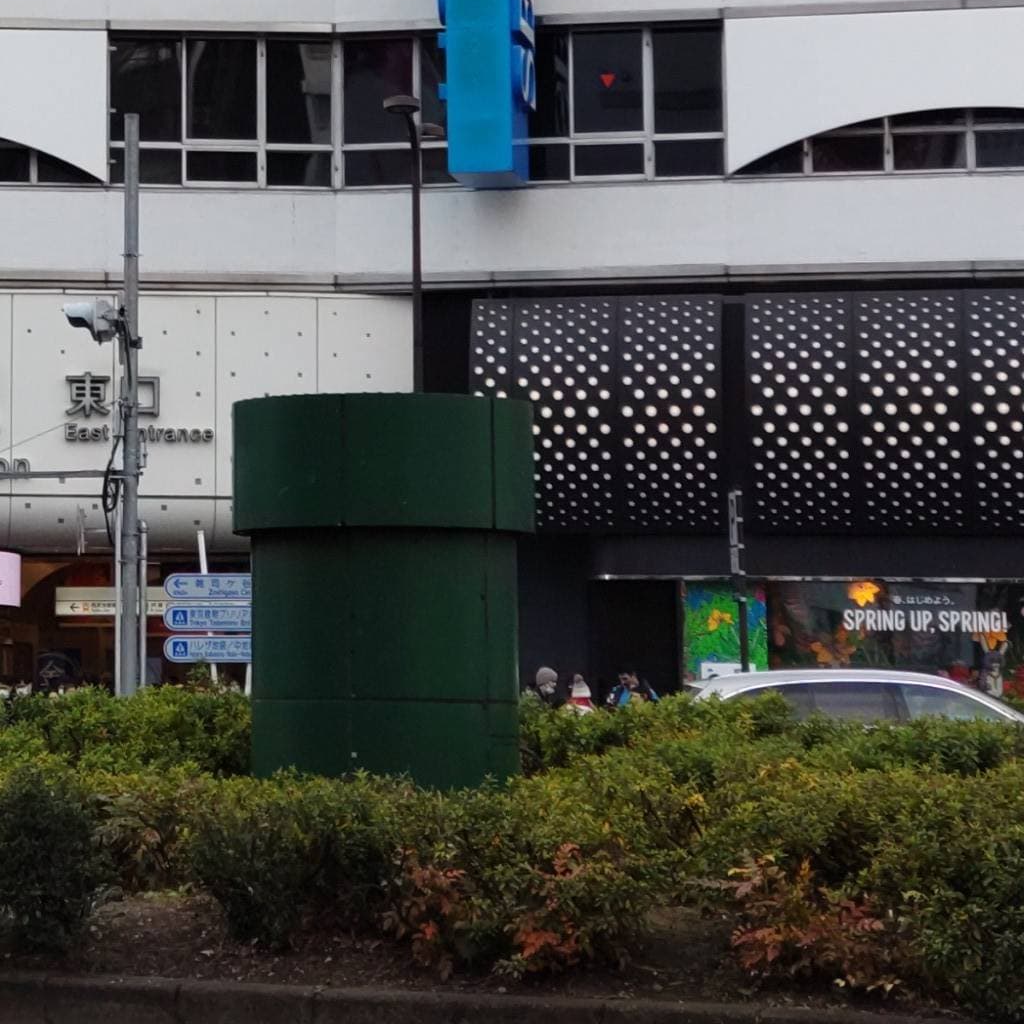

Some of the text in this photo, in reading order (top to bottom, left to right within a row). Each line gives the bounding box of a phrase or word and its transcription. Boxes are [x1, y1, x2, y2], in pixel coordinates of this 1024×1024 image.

[64, 372, 161, 417] 東口
[64, 423, 215, 443] East ntrance
[843, 609, 1008, 634] SPRING UP, SPRING!
